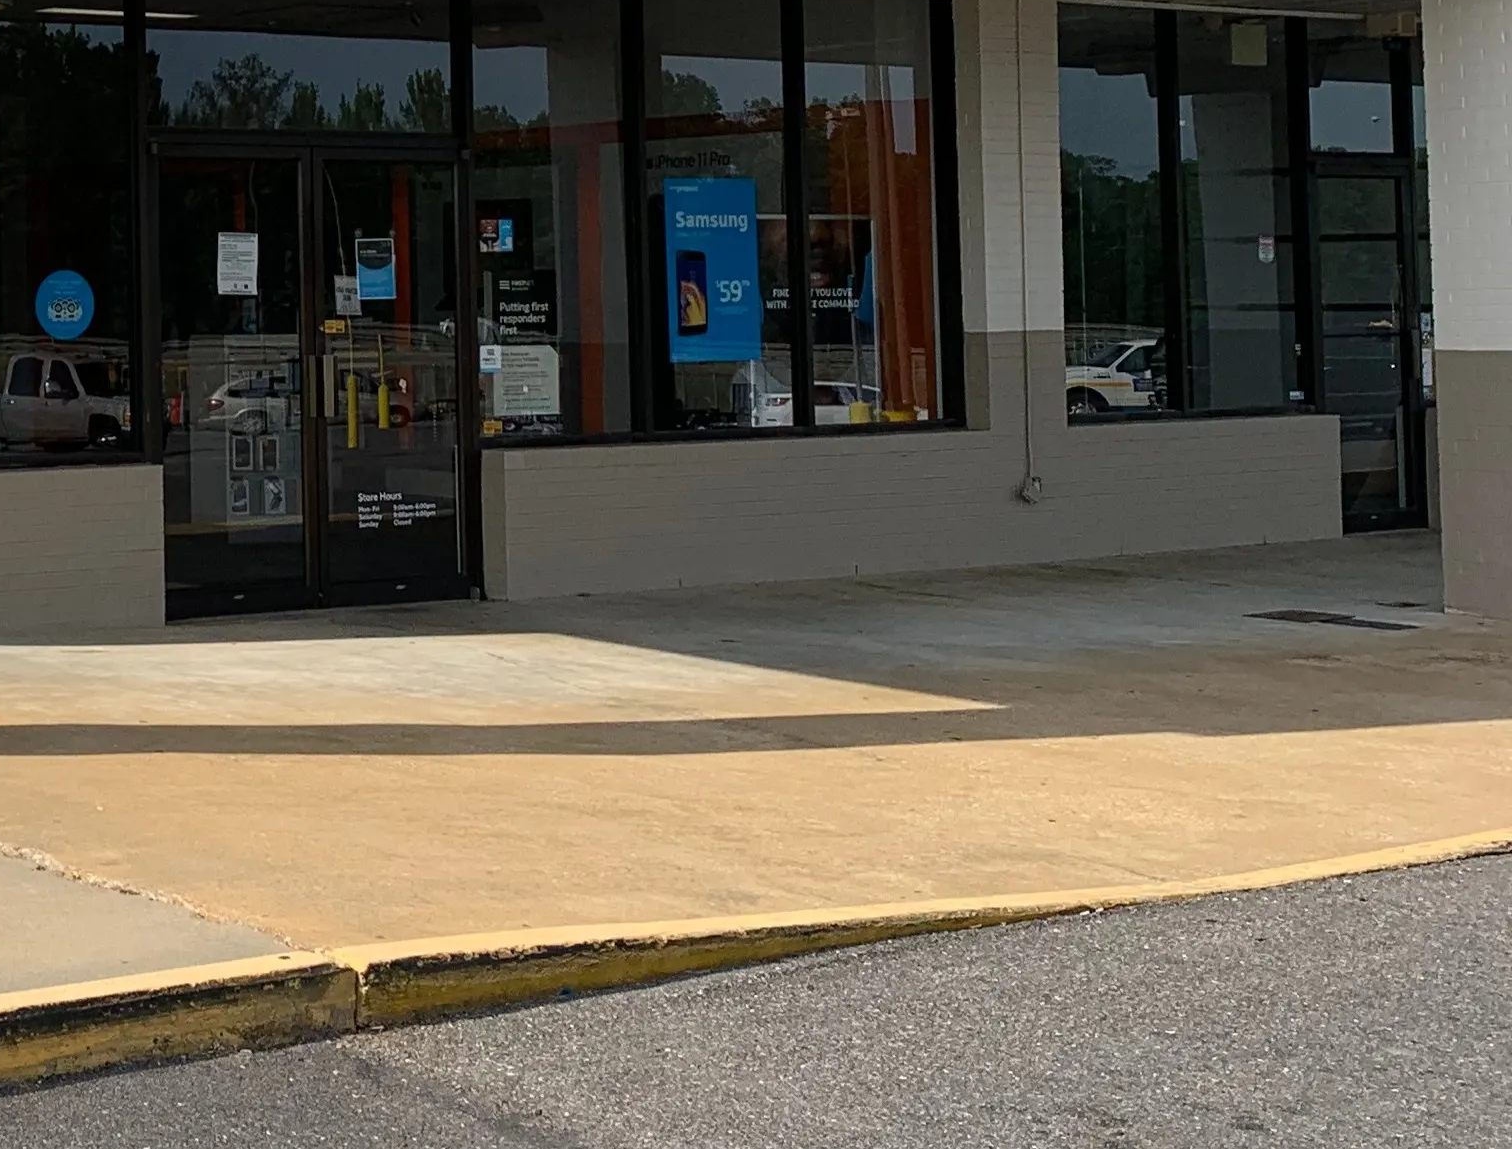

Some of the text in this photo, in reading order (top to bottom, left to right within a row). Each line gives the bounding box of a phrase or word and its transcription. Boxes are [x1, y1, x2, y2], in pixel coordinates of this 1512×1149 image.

[709, 150, 731, 166] Pro
[675, 211, 748, 232] Samsung
[814, 288, 831, 298] YOU
[499, 301, 549, 314] Putting first
[765, 299, 788, 309] WITH
[499, 313, 546, 325] responders
[499, 325, 518, 335] first
[358, 492, 402, 502] Store Hours
